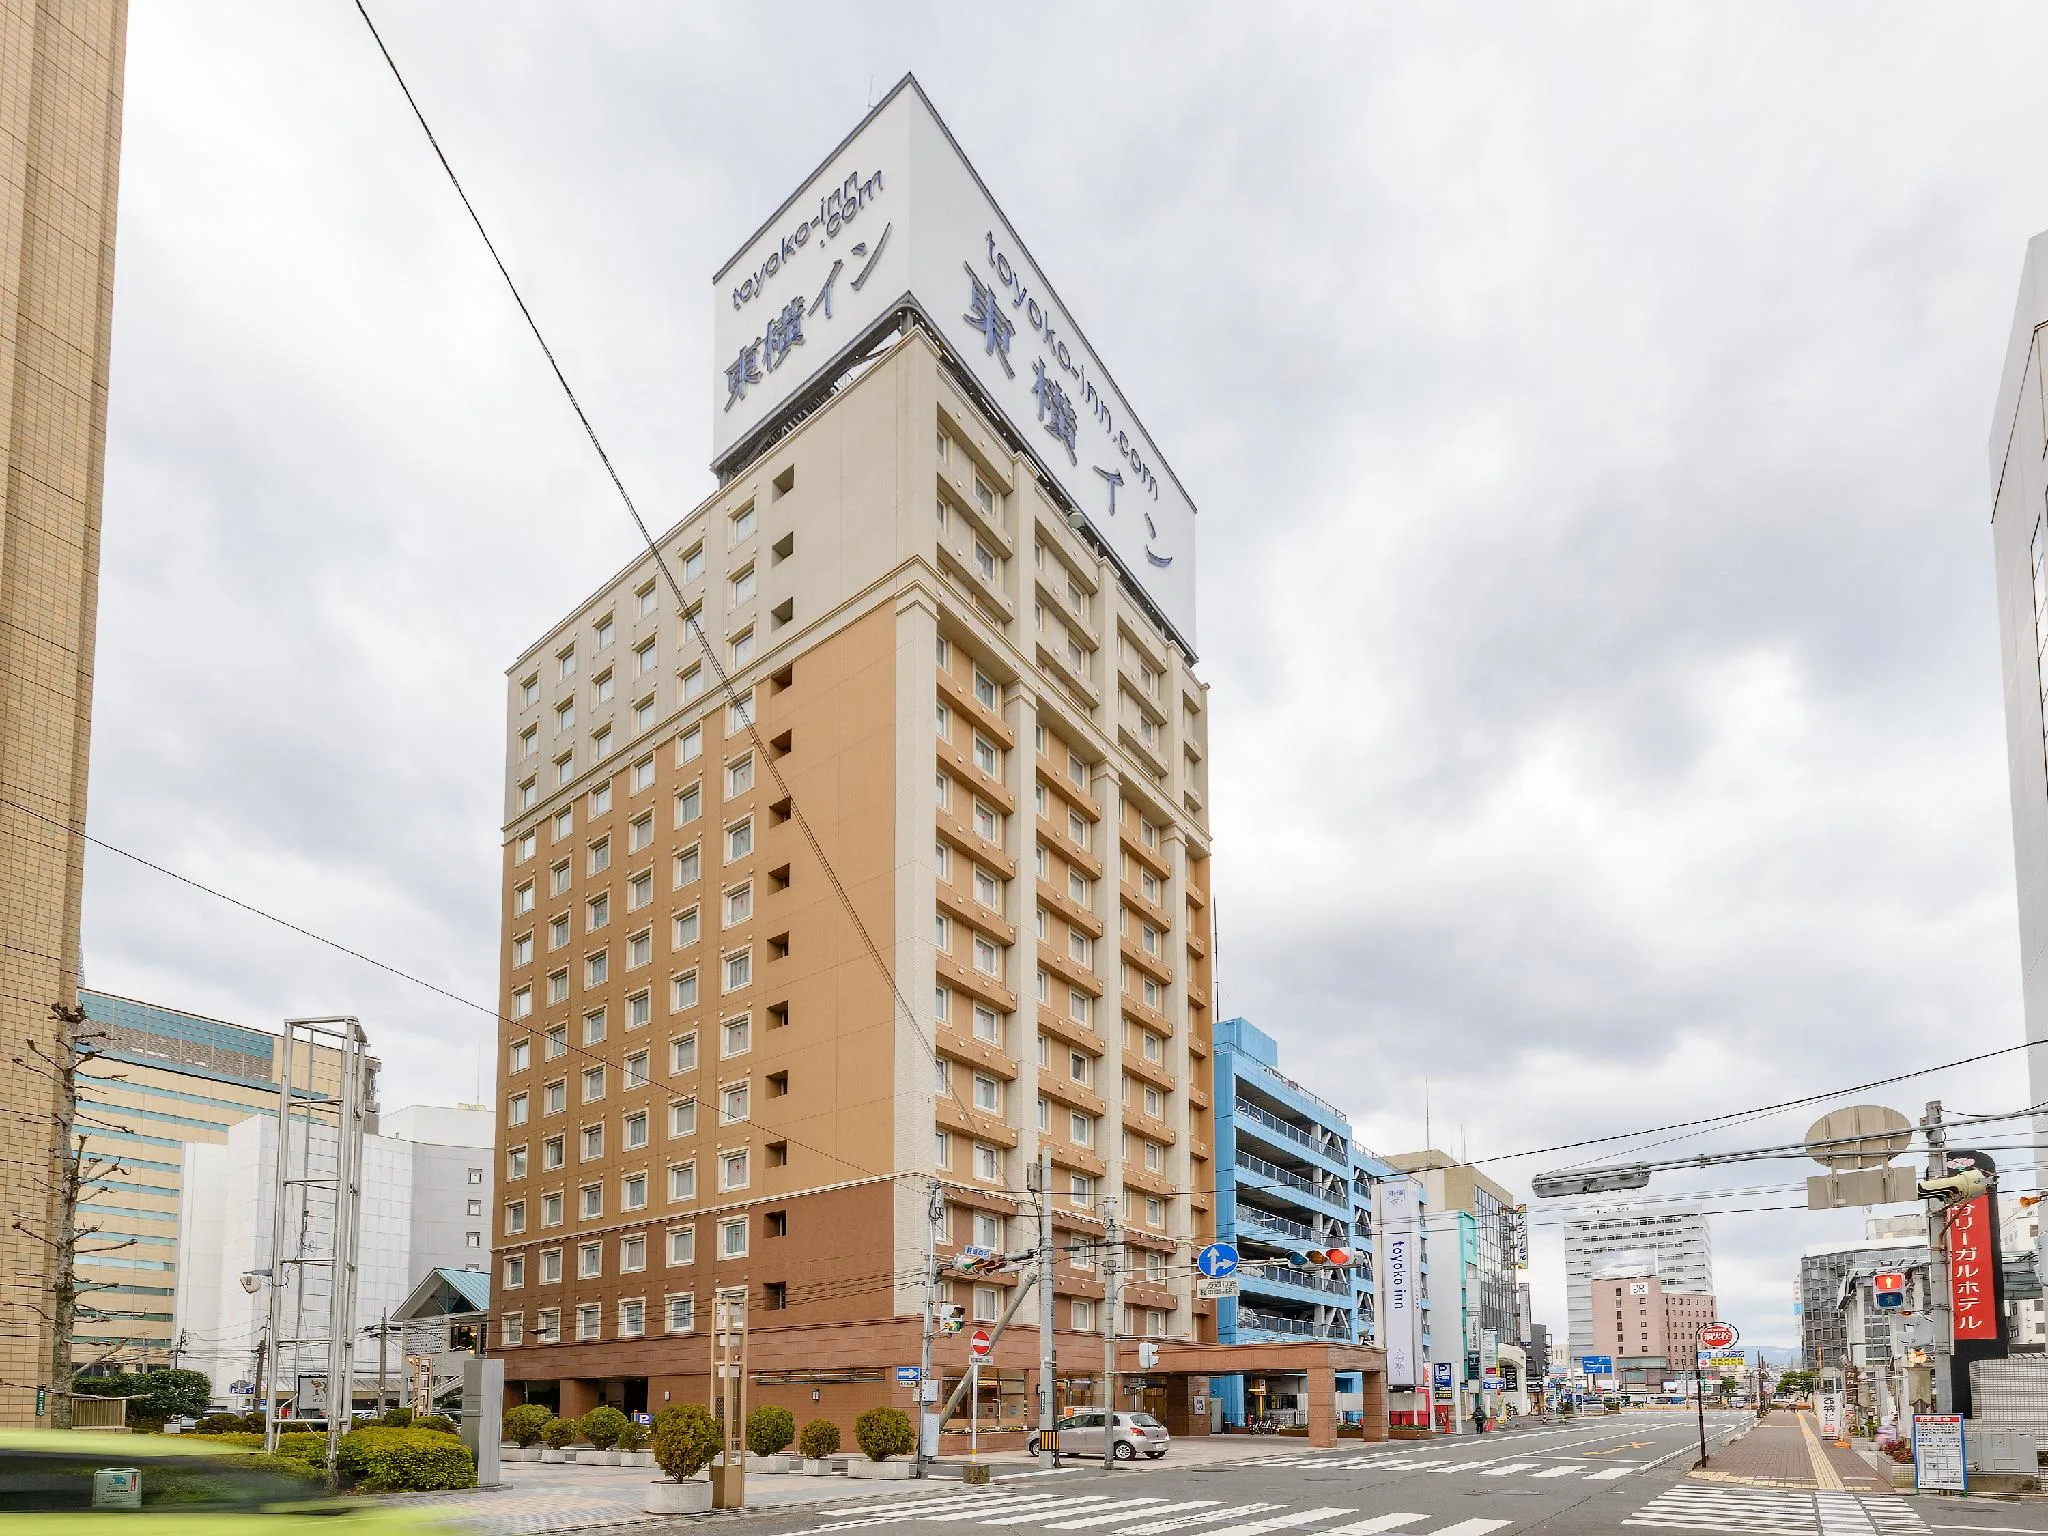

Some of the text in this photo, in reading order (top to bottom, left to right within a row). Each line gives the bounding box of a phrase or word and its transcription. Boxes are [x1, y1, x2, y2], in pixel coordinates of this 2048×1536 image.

[733, 171, 858, 311] toyoko-inn
[820, 170, 884, 247] .com
[724, 222, 891, 414] 東横イン
[985, 230, 1158, 501] toyoko-inn.com
[962, 260, 1172, 569] 東横イン
[1390, 1241, 1407, 1310] toyoko inn
[1954, 1216, 1982, 1329] リーガルホテル
[639, 1414, 650, 1424] P
